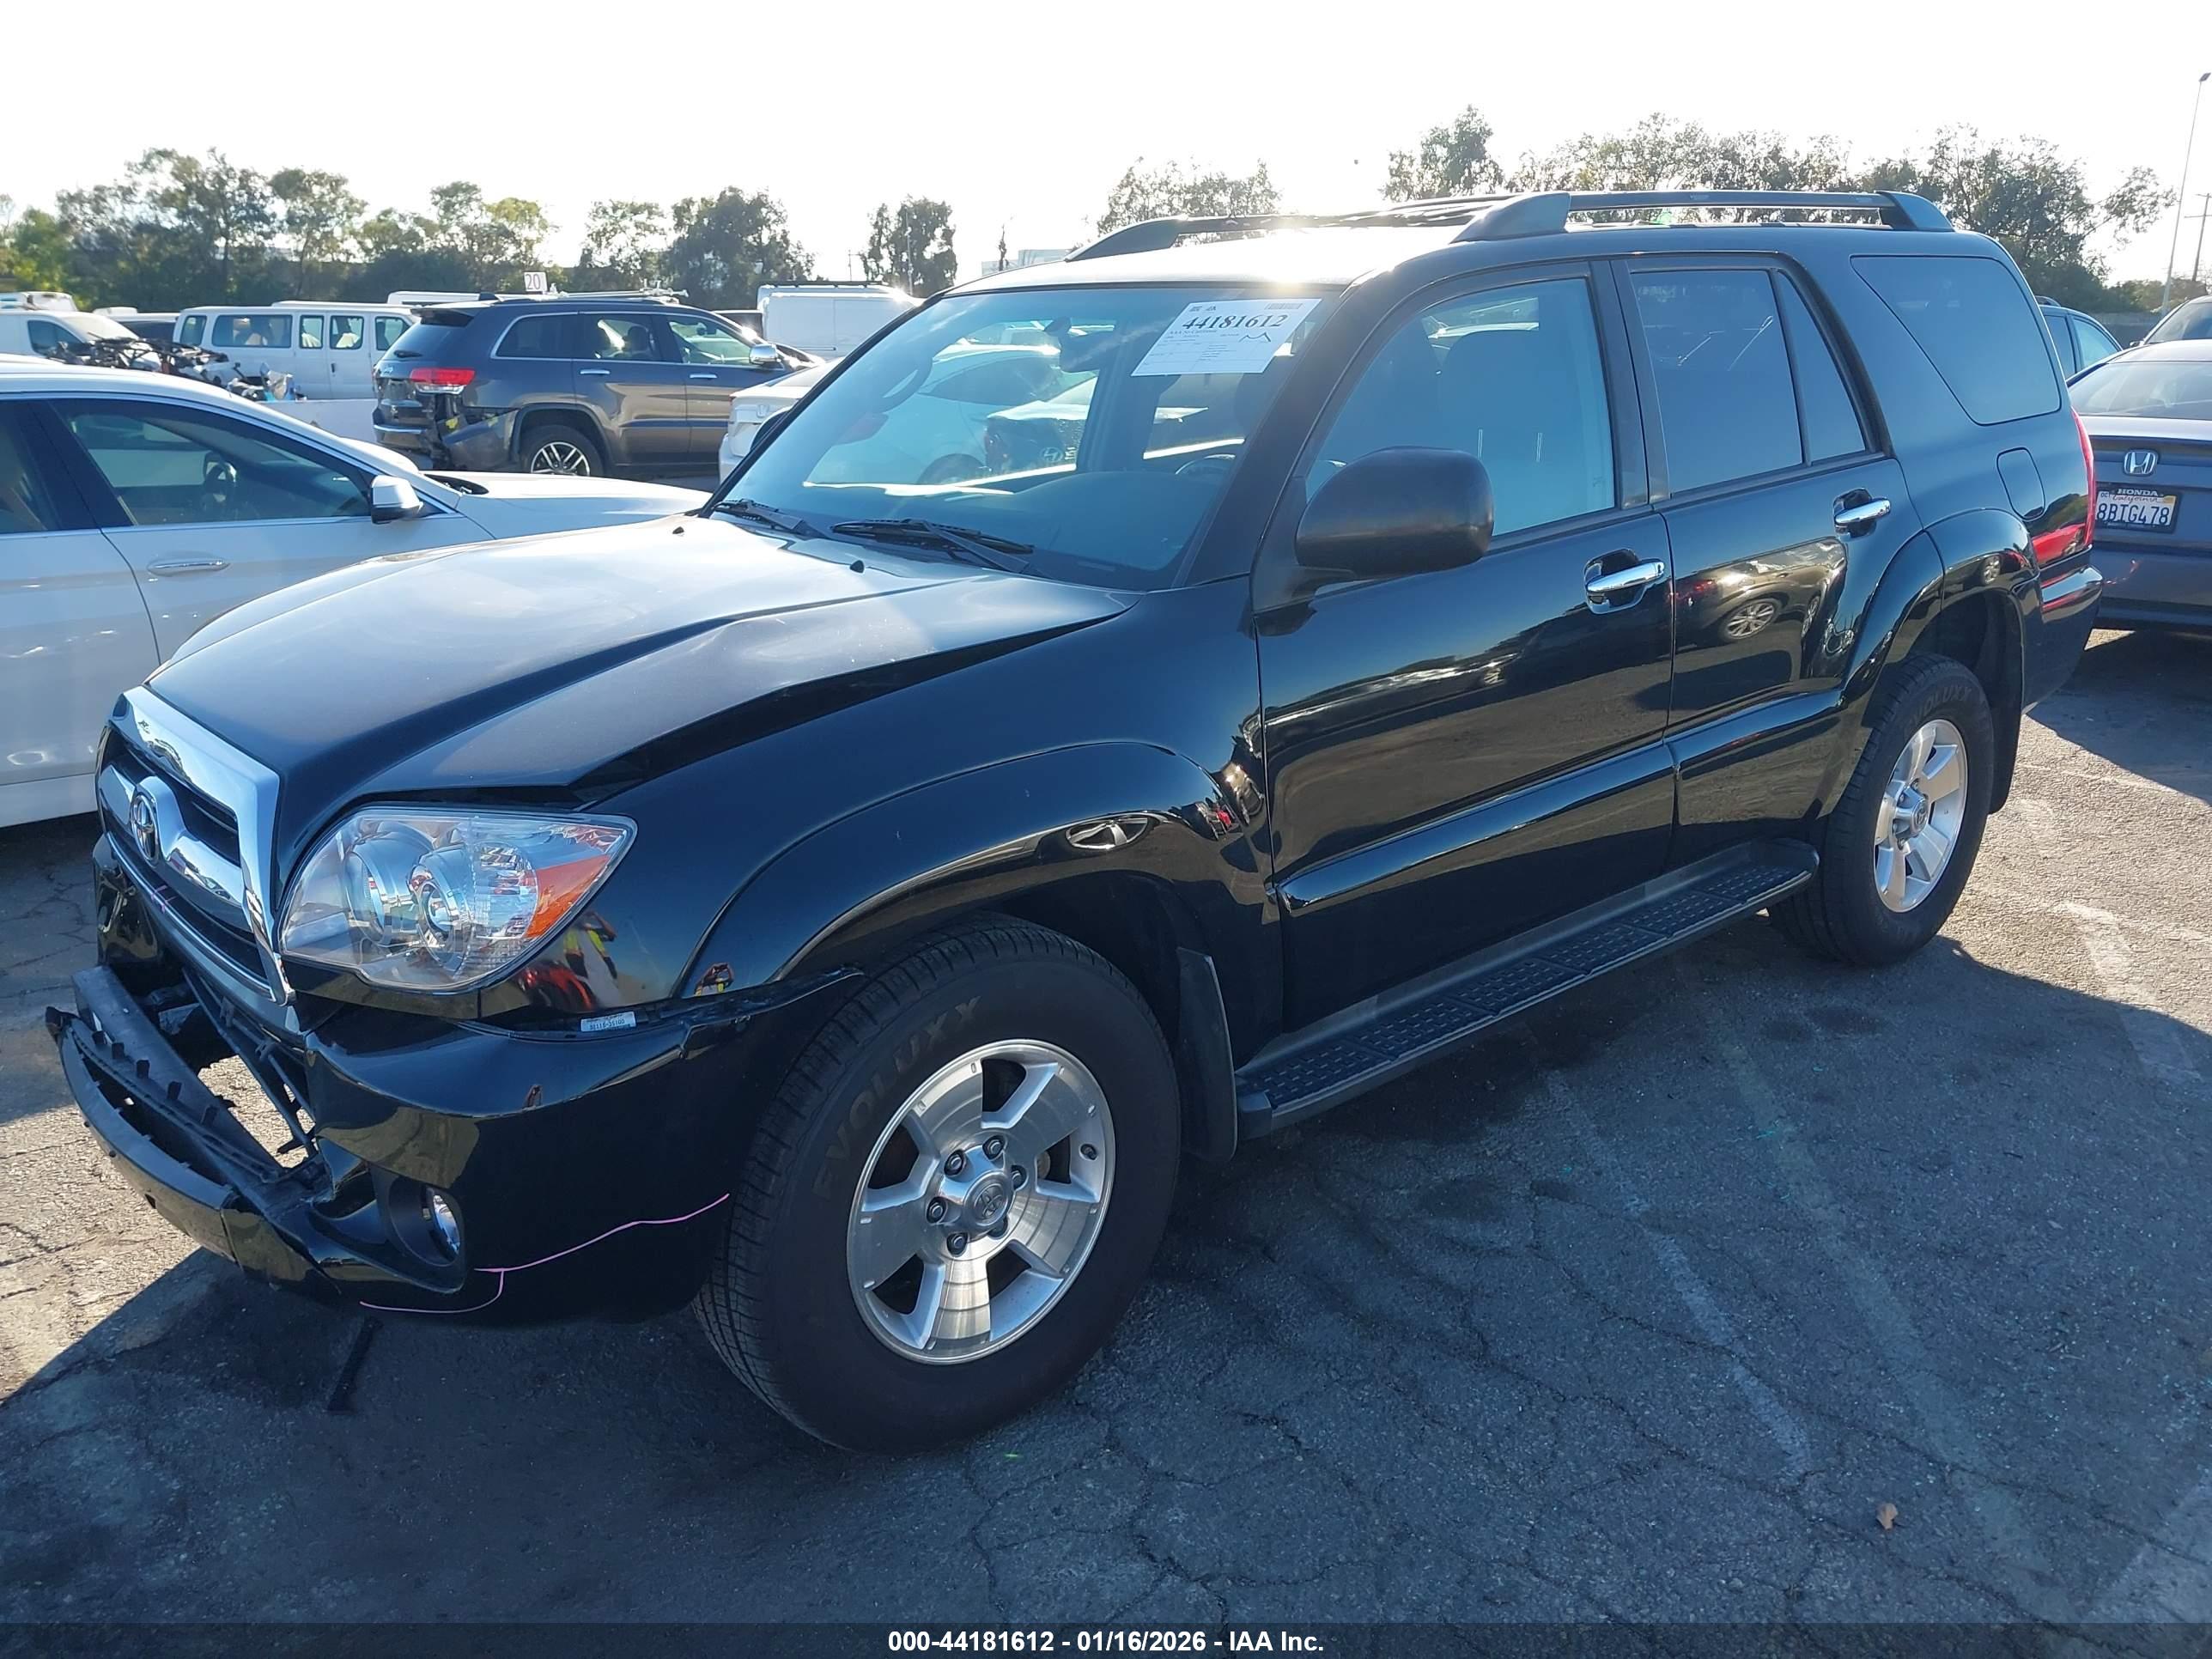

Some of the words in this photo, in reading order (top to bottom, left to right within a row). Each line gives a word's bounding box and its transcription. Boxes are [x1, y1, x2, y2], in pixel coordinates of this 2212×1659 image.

[526, 273, 541, 289] 20
[1182, 314, 1289, 330] 44181612
[2096, 502, 2170, 526] 8BTG478
[811, 995, 982, 1203] EVOLUXX
